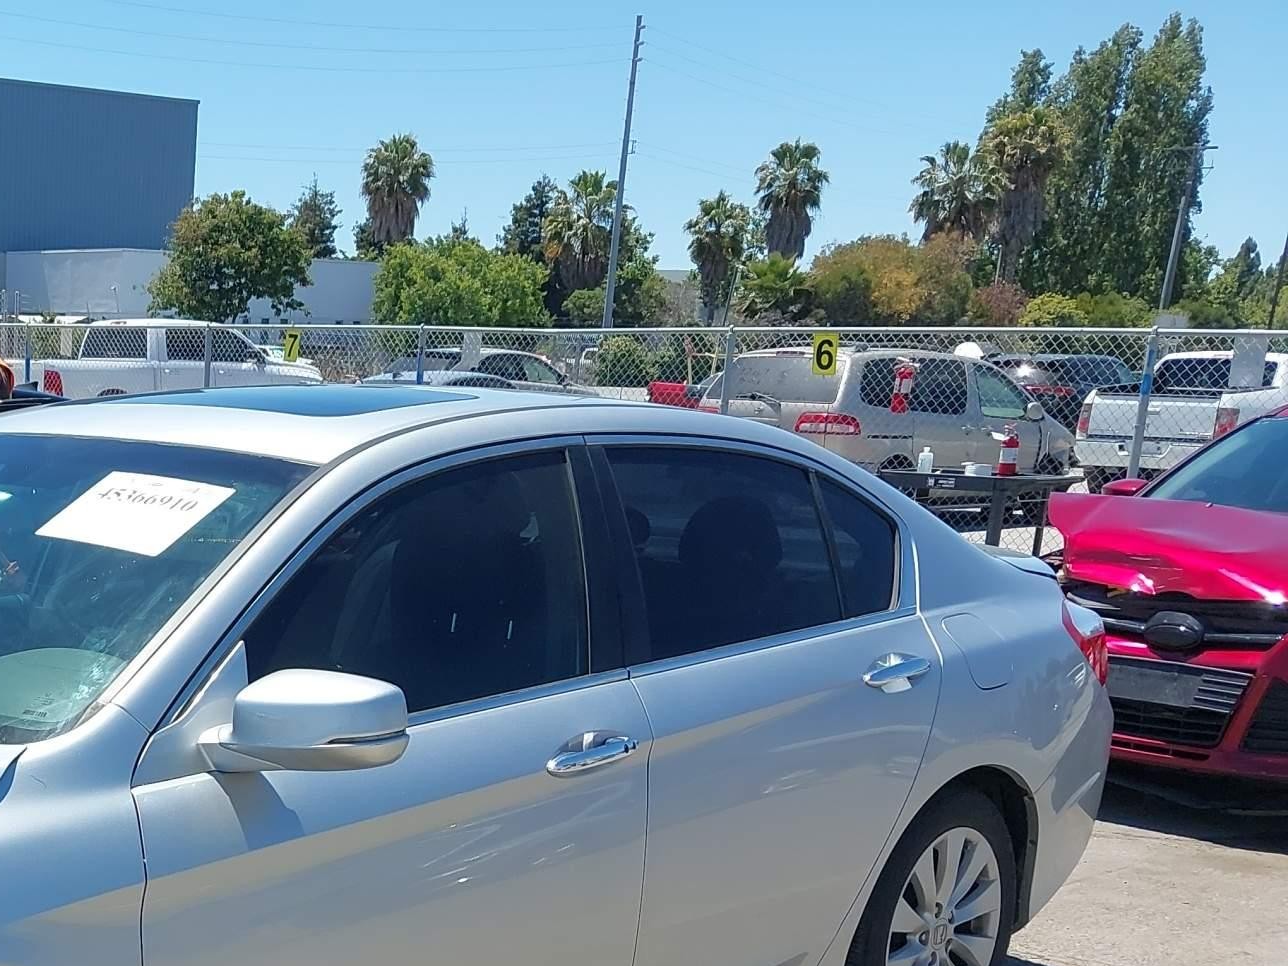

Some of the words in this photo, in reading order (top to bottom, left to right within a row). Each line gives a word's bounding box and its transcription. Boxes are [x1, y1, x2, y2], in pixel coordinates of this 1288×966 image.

[288, 334, 298, 357] 7
[816, 339, 834, 370] 6
[98, 487, 199, 512] 45366910
